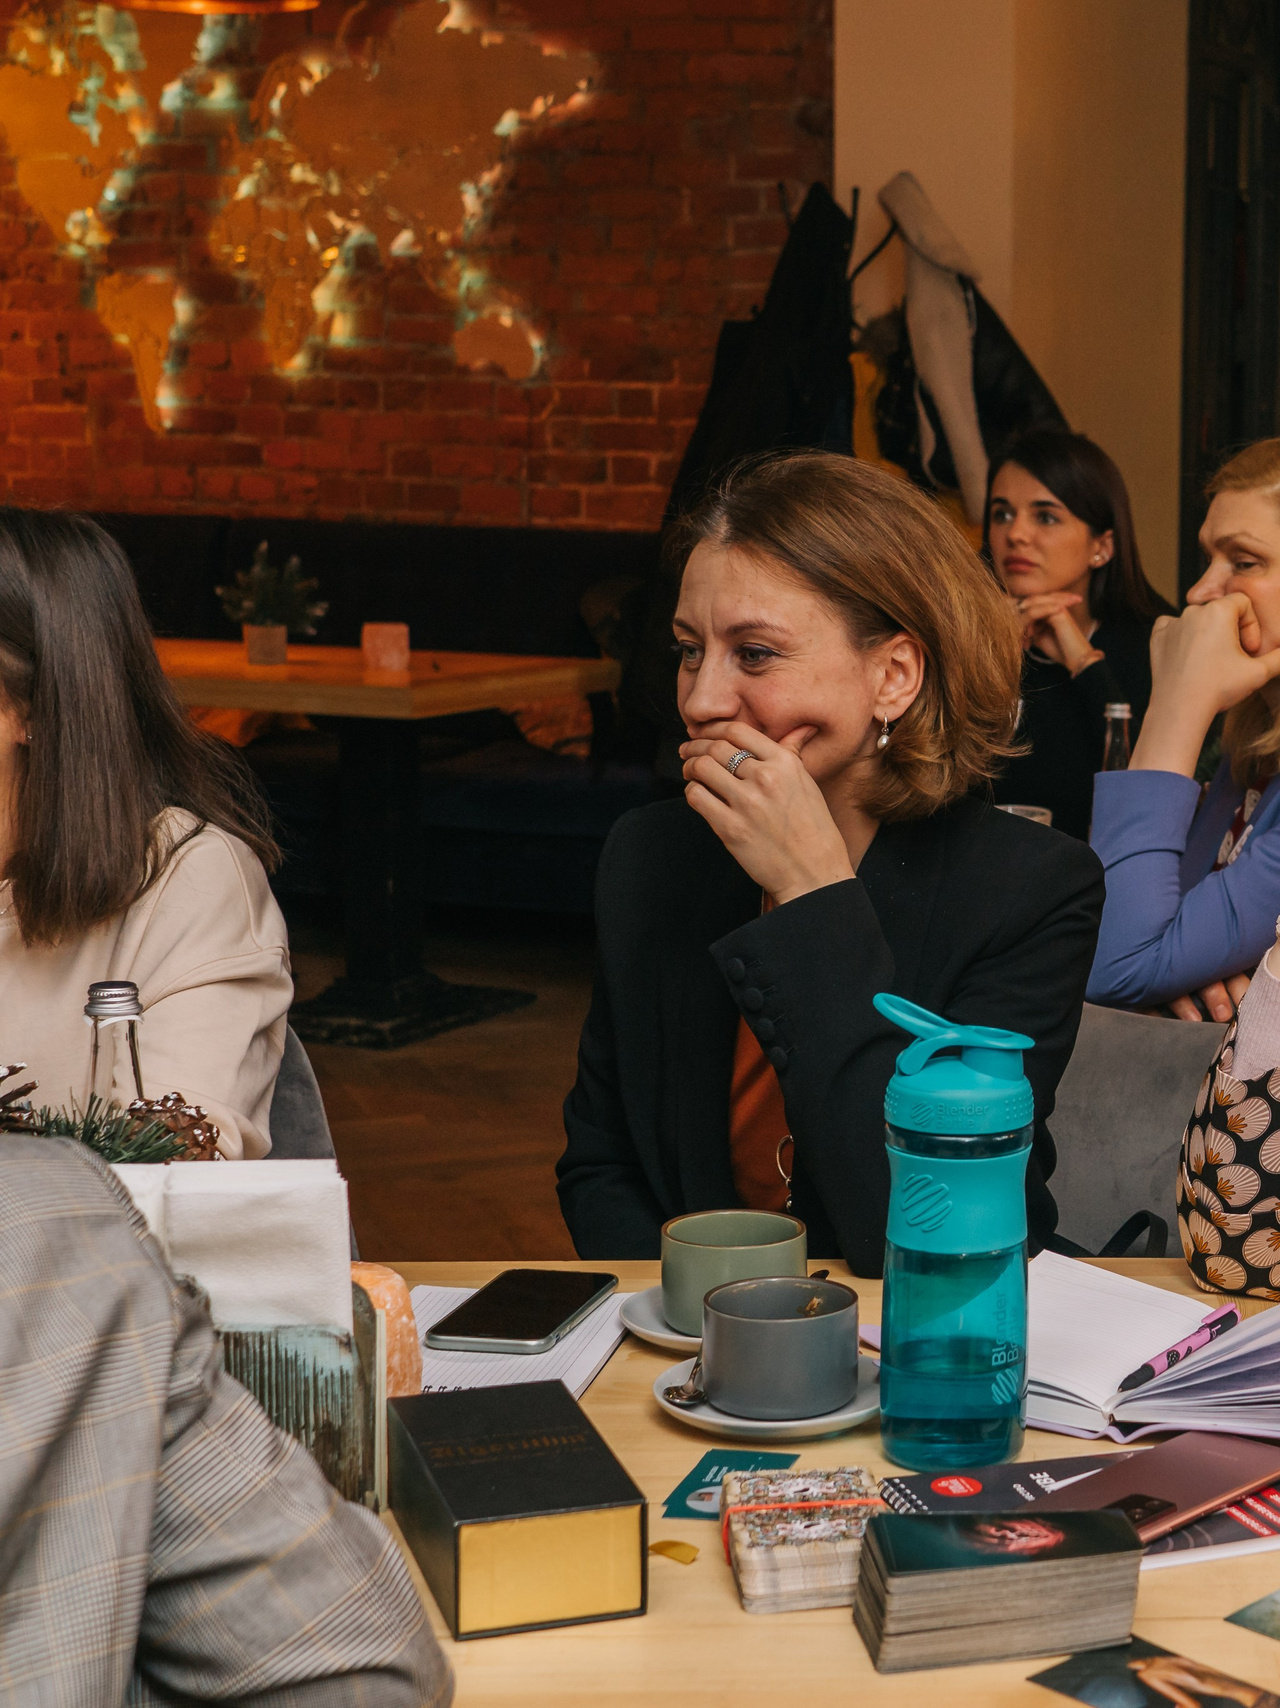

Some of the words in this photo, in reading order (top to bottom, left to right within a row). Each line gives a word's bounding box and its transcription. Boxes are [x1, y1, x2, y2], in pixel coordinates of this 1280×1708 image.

[935, 1102, 990, 1116] Blender
[935, 1116, 976, 1129] Bottle
[992, 1291, 1006, 1367] Blender
